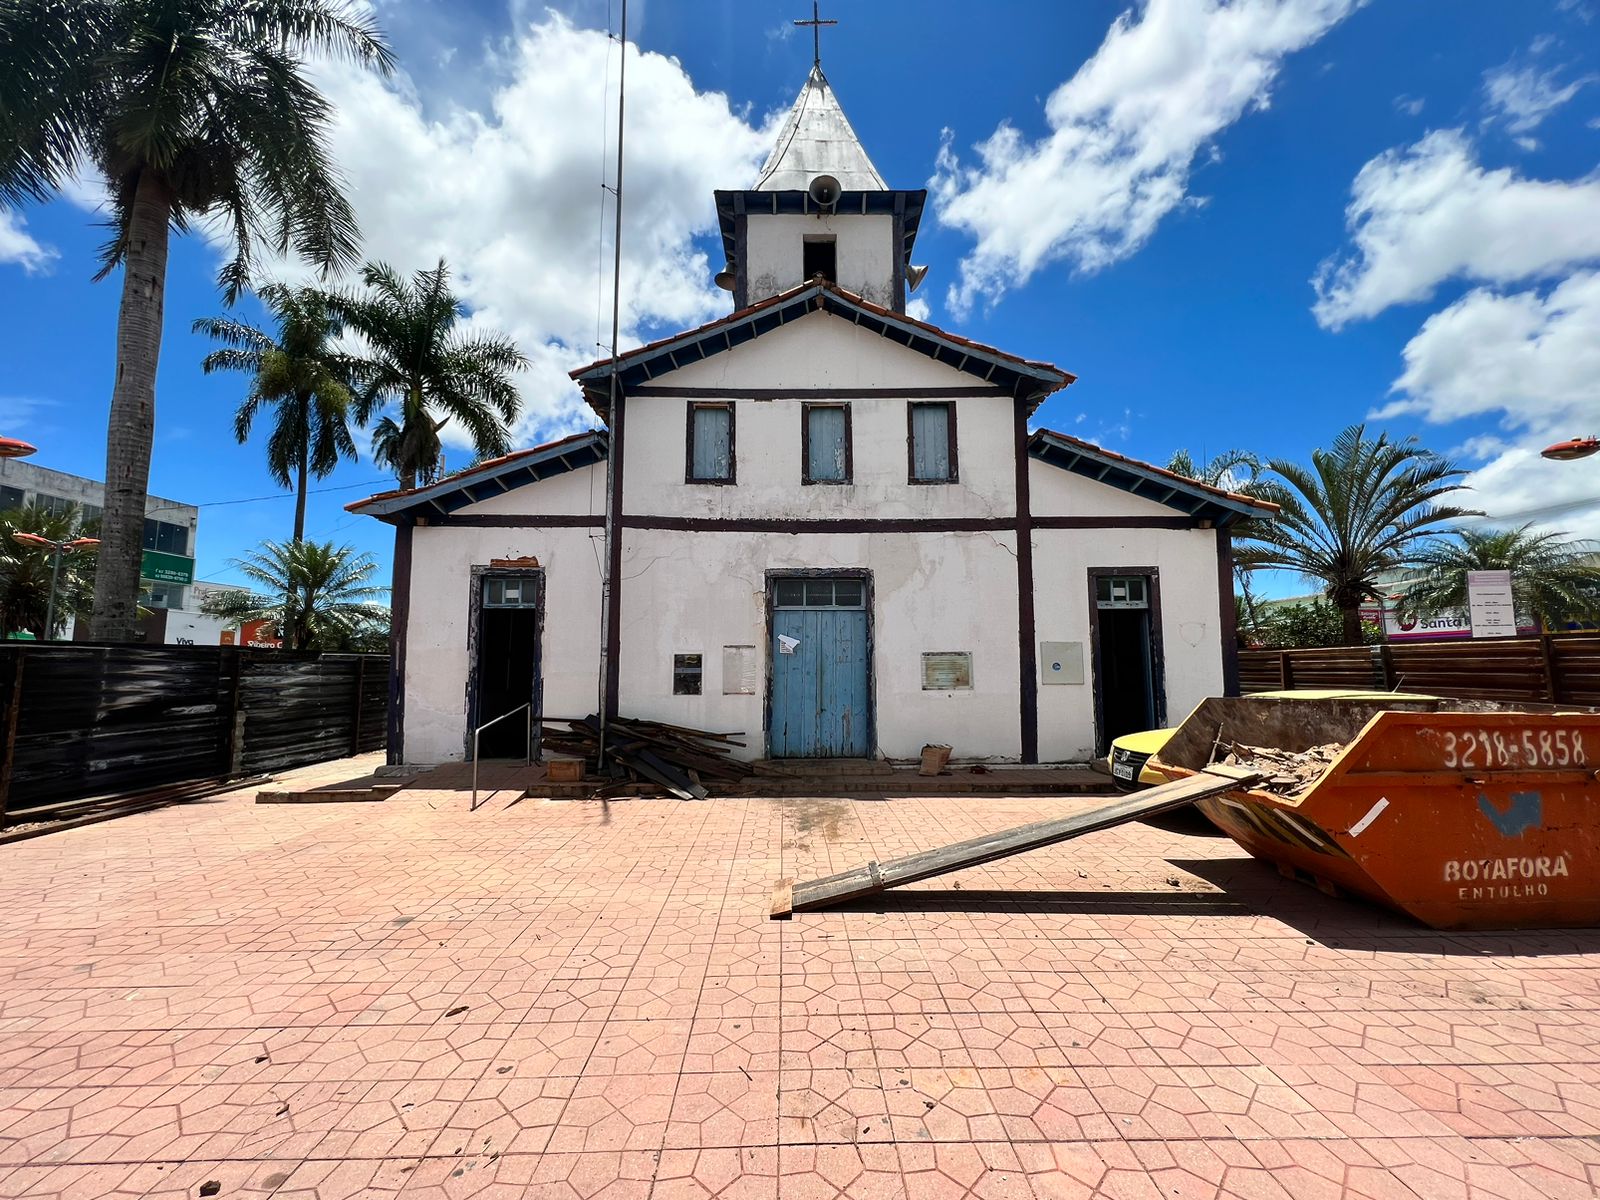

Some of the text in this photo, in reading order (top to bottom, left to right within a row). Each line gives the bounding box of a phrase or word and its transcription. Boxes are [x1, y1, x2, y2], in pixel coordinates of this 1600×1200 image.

[1420, 617, 1462, 629] Santa
[1444, 729, 1585, 768] 3218-5858
[1444, 855, 1569, 882] BOTAFORA
[1458, 883, 1548, 900] ENTULHO
